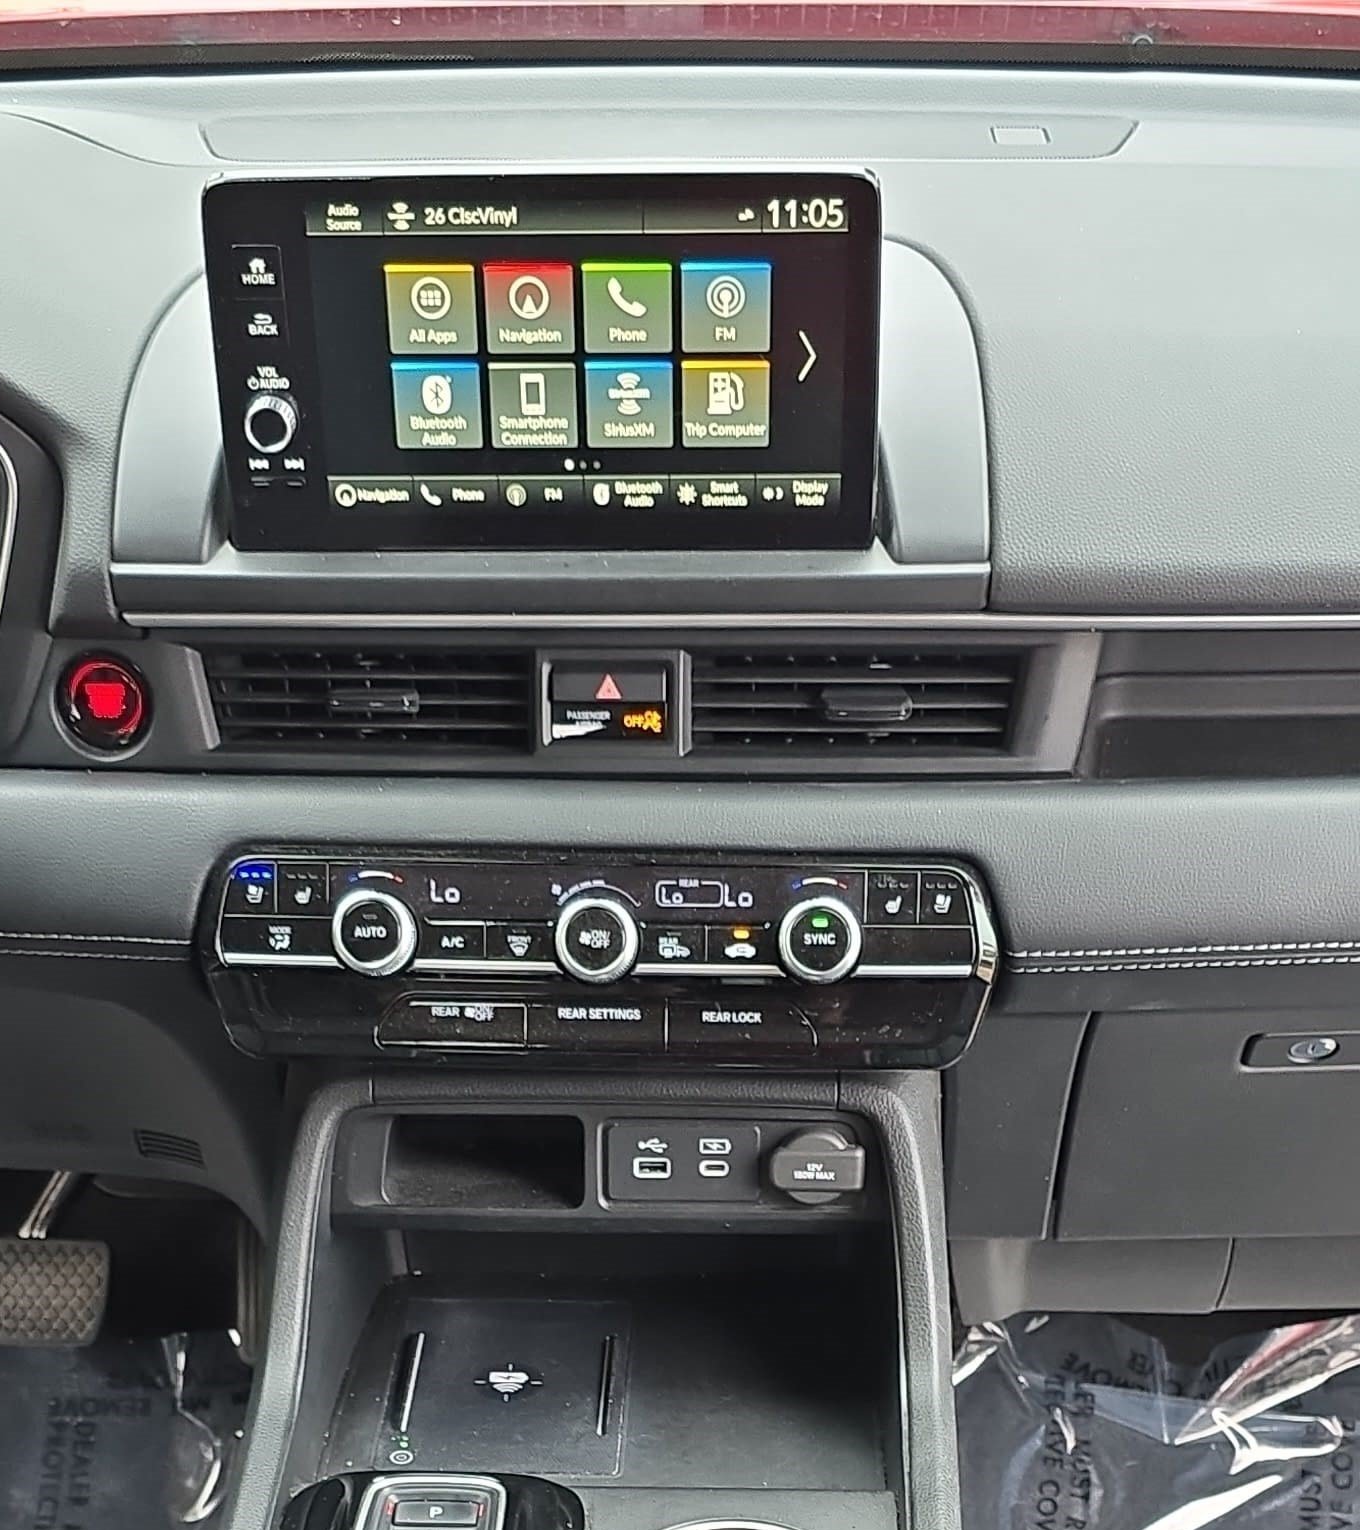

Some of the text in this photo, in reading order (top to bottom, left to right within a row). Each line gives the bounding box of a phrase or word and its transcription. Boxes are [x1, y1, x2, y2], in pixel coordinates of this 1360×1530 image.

[327, 204, 359, 217] Audio
[424, 208, 446, 225] 26
[767, 199, 844, 229] 11:05
[326, 219, 362, 231] Source
[241, 274, 275, 286] HOME
[248, 324, 278, 336] BACK
[609, 327, 647, 342] Phone
[715, 327, 737, 342] FM
[409, 329, 457, 345] All Apps
[499, 329, 562, 345] Navigation
[257, 366, 278, 378] VOL
[260, 377, 290, 390] AUDIO
[410, 416, 467, 431] Bluetooth
[499, 416, 568, 432] Smartphone
[604, 423, 655, 438] SiriusXM
[685, 423, 767, 440] Trip Computer
[422, 432, 456, 446] Audio
[501, 432, 567, 446] Connection
[615, 481, 663, 495] Bluetooth
[710, 481, 739, 494] Smart
[792, 480, 828, 496] Display
[357, 488, 410, 503] Navigation
[452, 488, 485, 502] Phone
[544, 488, 563, 501] FM
[624, 494, 655, 508] Audio
[701, 493, 748, 507] Shortcuts
[795, 494, 825, 507] Mode
[566, 710, 611, 720] PASSENGER
[623, 714, 644, 728] OFF
[678, 878, 699, 888] REAR
[354, 926, 386, 939] AUTO
[803, 932, 836, 945] SYNC
[441, 936, 464, 949] A/C
[507, 935, 532, 944] FRONT
[591, 939, 610, 949] OFF
[658, 937, 679, 945] REAR
[431, 1006, 460, 1018] REAR
[557, 1007, 641, 1021] REAR SETTINGS
[702, 1011, 762, 1024] REAR LOCK
[815, 1171, 835, 1181] MAX
[429, 1507, 443, 1518] P
